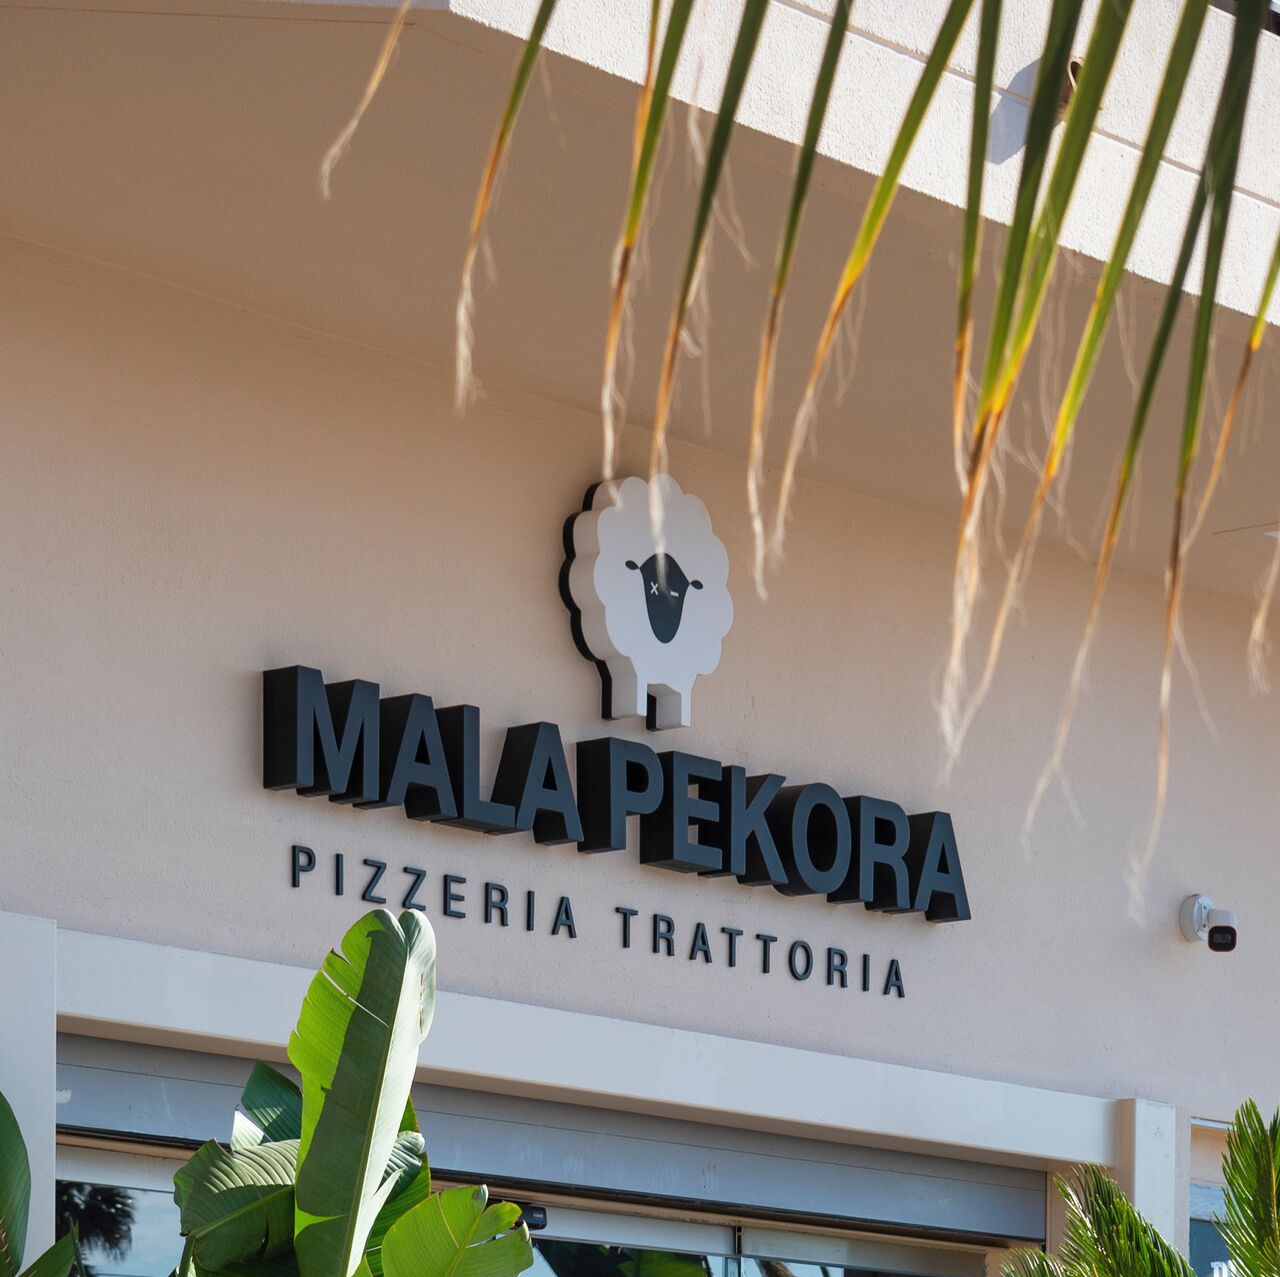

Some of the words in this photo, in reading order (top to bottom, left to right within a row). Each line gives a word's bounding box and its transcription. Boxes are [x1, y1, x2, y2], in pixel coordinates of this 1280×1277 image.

[263, 664, 584, 846] MALA
[577, 736, 972, 923] PEKORA
[291, 844, 578, 939] PIZZERIA
[615, 905, 907, 999] TRATTORIA
